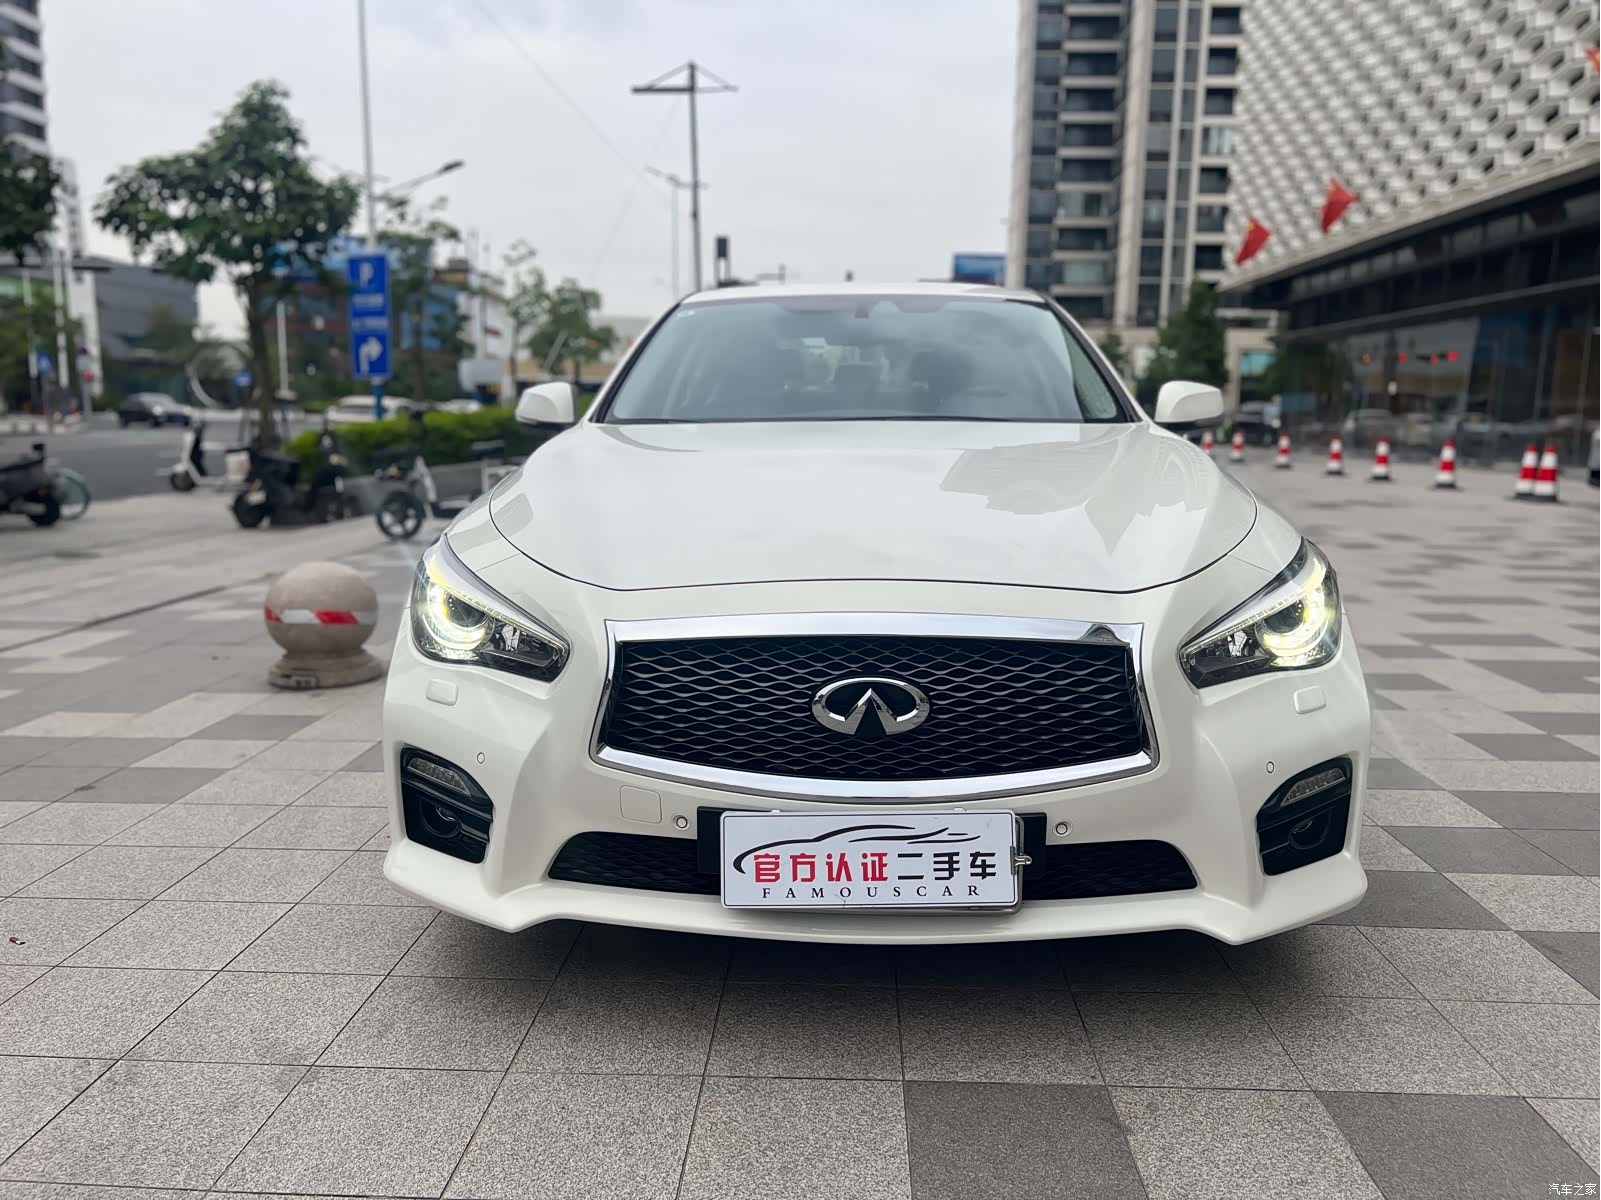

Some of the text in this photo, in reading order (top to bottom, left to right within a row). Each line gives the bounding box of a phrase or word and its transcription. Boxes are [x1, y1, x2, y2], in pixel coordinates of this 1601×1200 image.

[359, 262, 374, 288] P
[753, 851, 997, 883] 官方认证二手车
